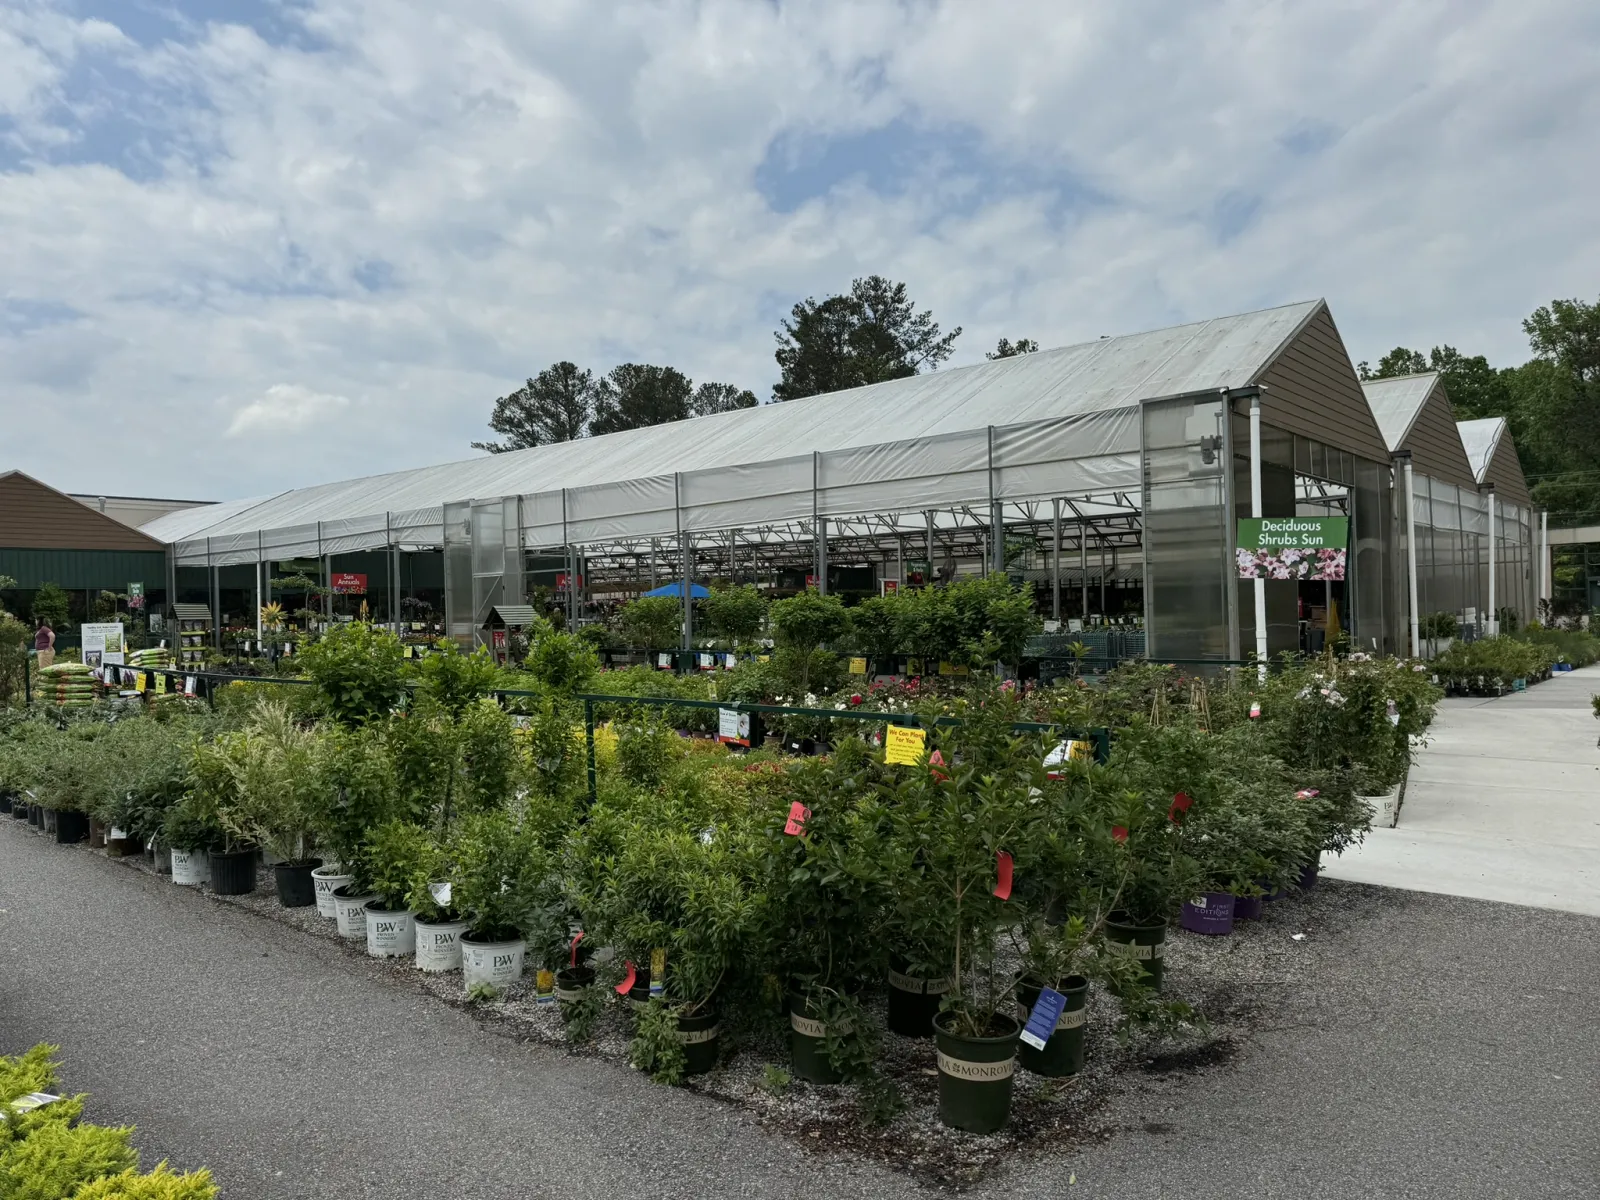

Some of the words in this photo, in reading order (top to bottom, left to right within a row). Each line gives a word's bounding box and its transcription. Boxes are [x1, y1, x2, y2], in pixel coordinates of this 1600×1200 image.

[1262, 519, 1321, 531] Deciduous
[1258, 533, 1298, 545] Shrubs
[1302, 534, 1323, 545] Sun
[1194, 908, 1229, 916] EDITIONS
